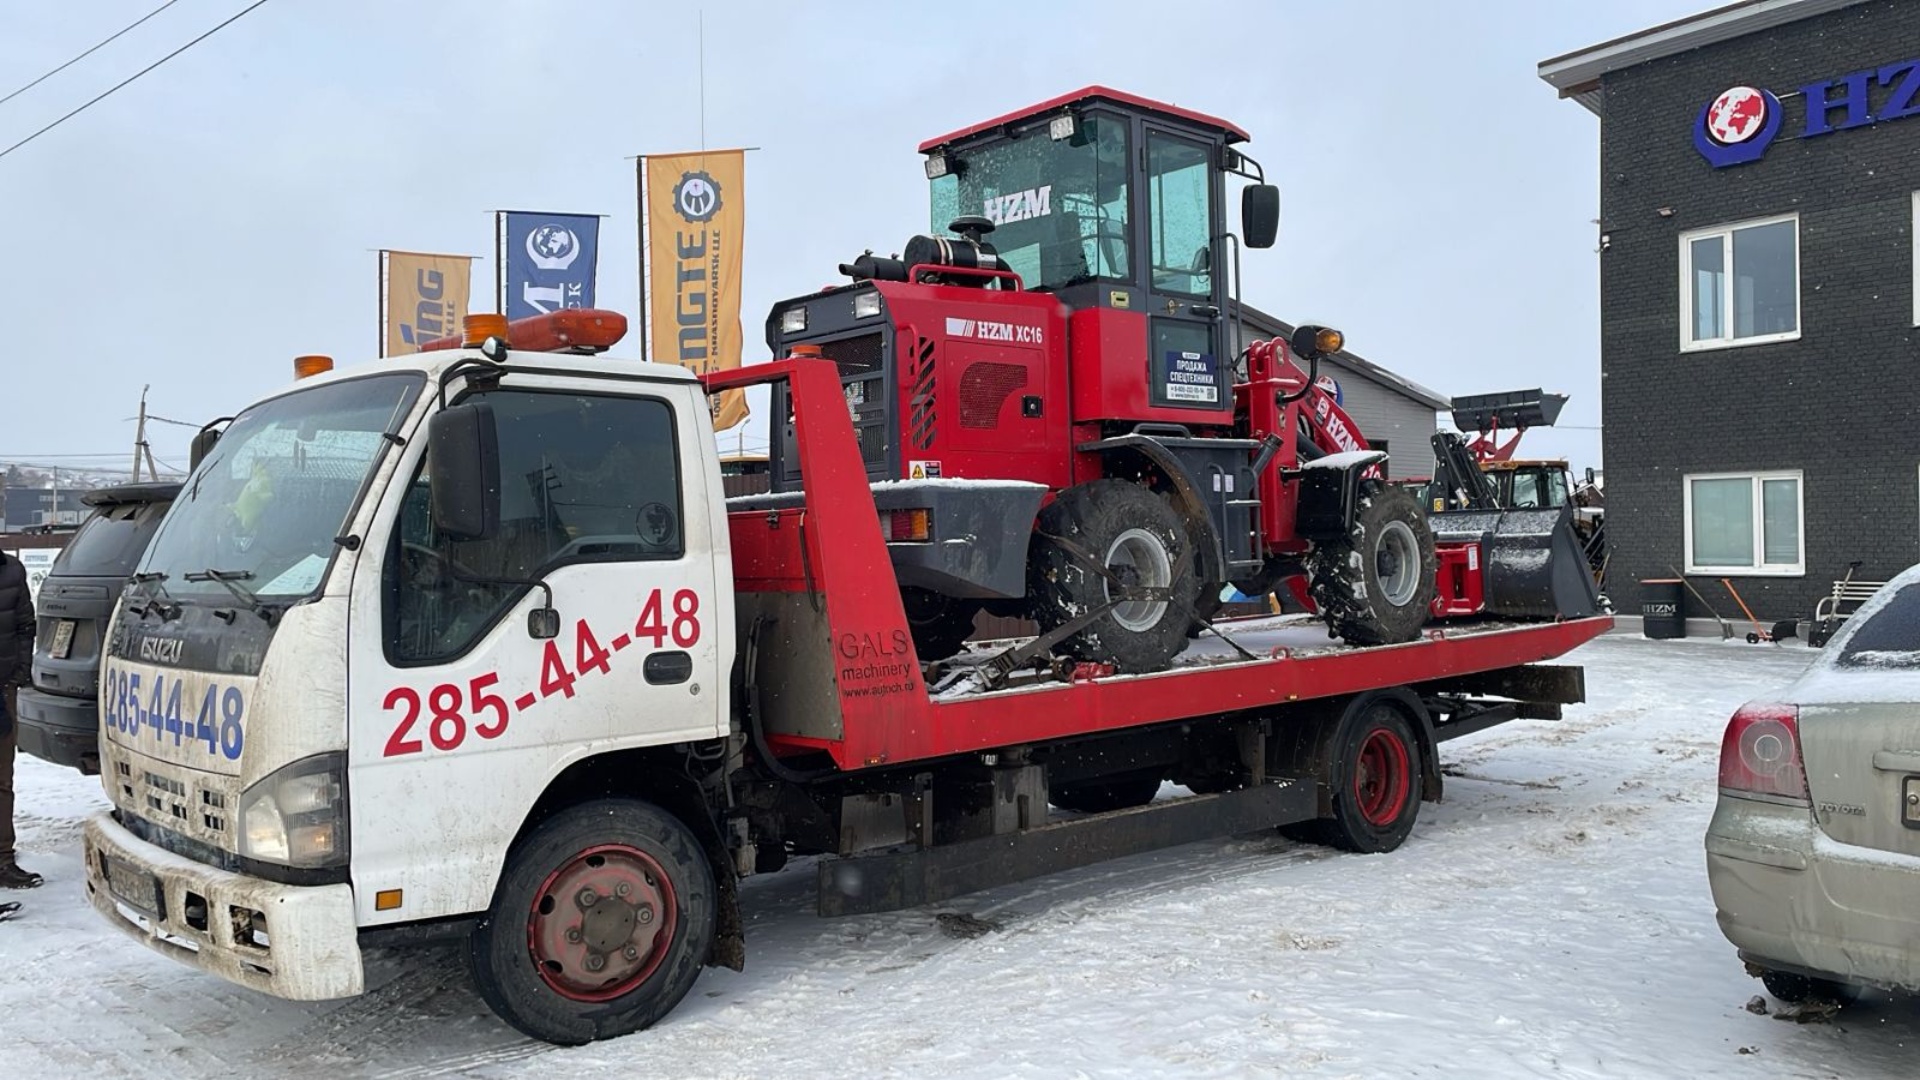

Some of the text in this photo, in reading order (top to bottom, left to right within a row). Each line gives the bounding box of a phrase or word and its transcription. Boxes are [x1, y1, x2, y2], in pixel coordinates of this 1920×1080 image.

[983, 185, 1052, 227] HZM
[712, 230, 721, 252] LLC
[977, 321, 1043, 343] HZM XC16
[1176, 360, 1207, 372] ПРОДАЖА
[1646, 604, 1676, 613] HZM
[141, 636, 184, 664] ISUZU
[840, 629, 909, 659] GALS
[383, 589, 701, 757] 285-44-48
[842, 663, 911, 681] machinery
[107, 667, 244, 760] 285-44-48
[1819, 802, 1867, 816] TOYOTA
